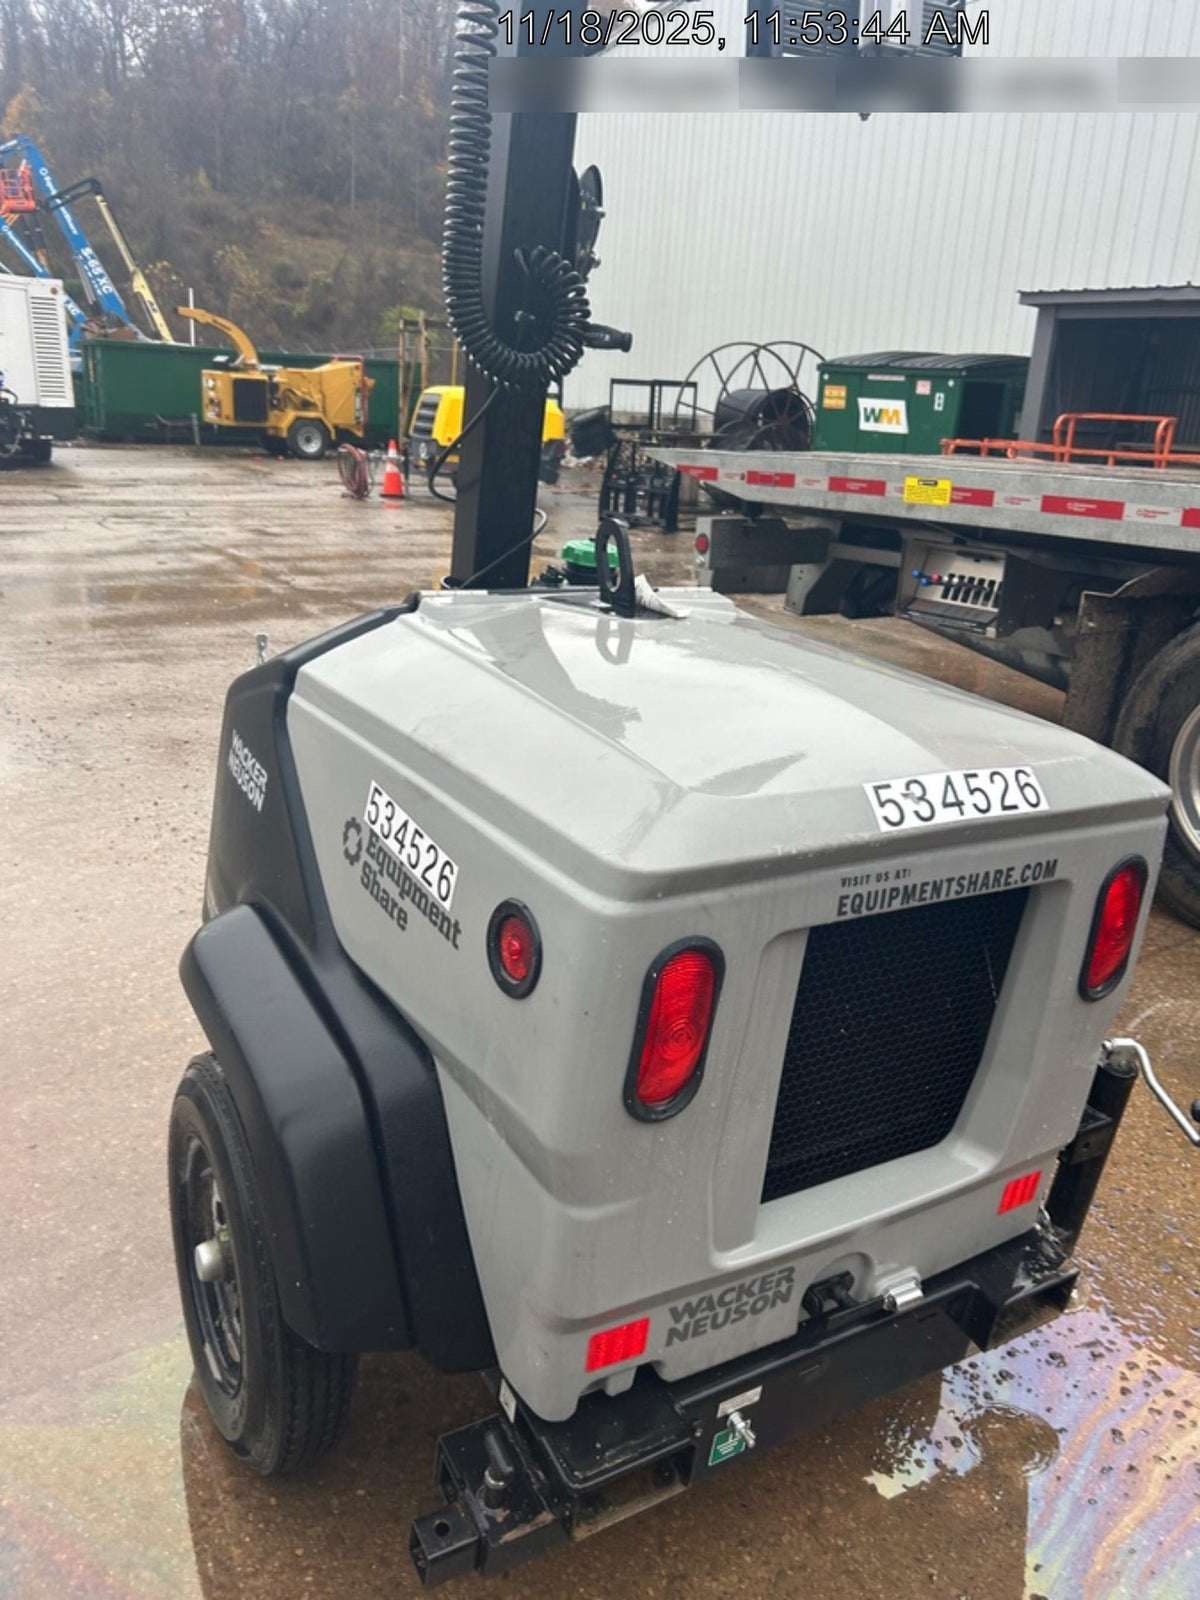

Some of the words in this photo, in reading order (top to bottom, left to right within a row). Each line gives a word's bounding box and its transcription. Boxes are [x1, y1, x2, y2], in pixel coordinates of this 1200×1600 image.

[862, 406, 902, 426] WM
[227, 748, 266, 812] NEUSON
[232, 728, 268, 793] WACKER
[872, 768, 1042, 828] 534526
[366, 786, 455, 903] 534526
[360, 859, 409, 932] Share
[365, 827, 463, 951] Equipment
[836, 858, 1059, 918] EQUIPMENTSHARE.COM
[840, 874, 871, 888] VISIT
[876, 871, 890, 883] US
[894, 868, 911, 881] AT:
[664, 1283, 795, 1348] NEUSON
[668, 1265, 796, 1324] WACKER
